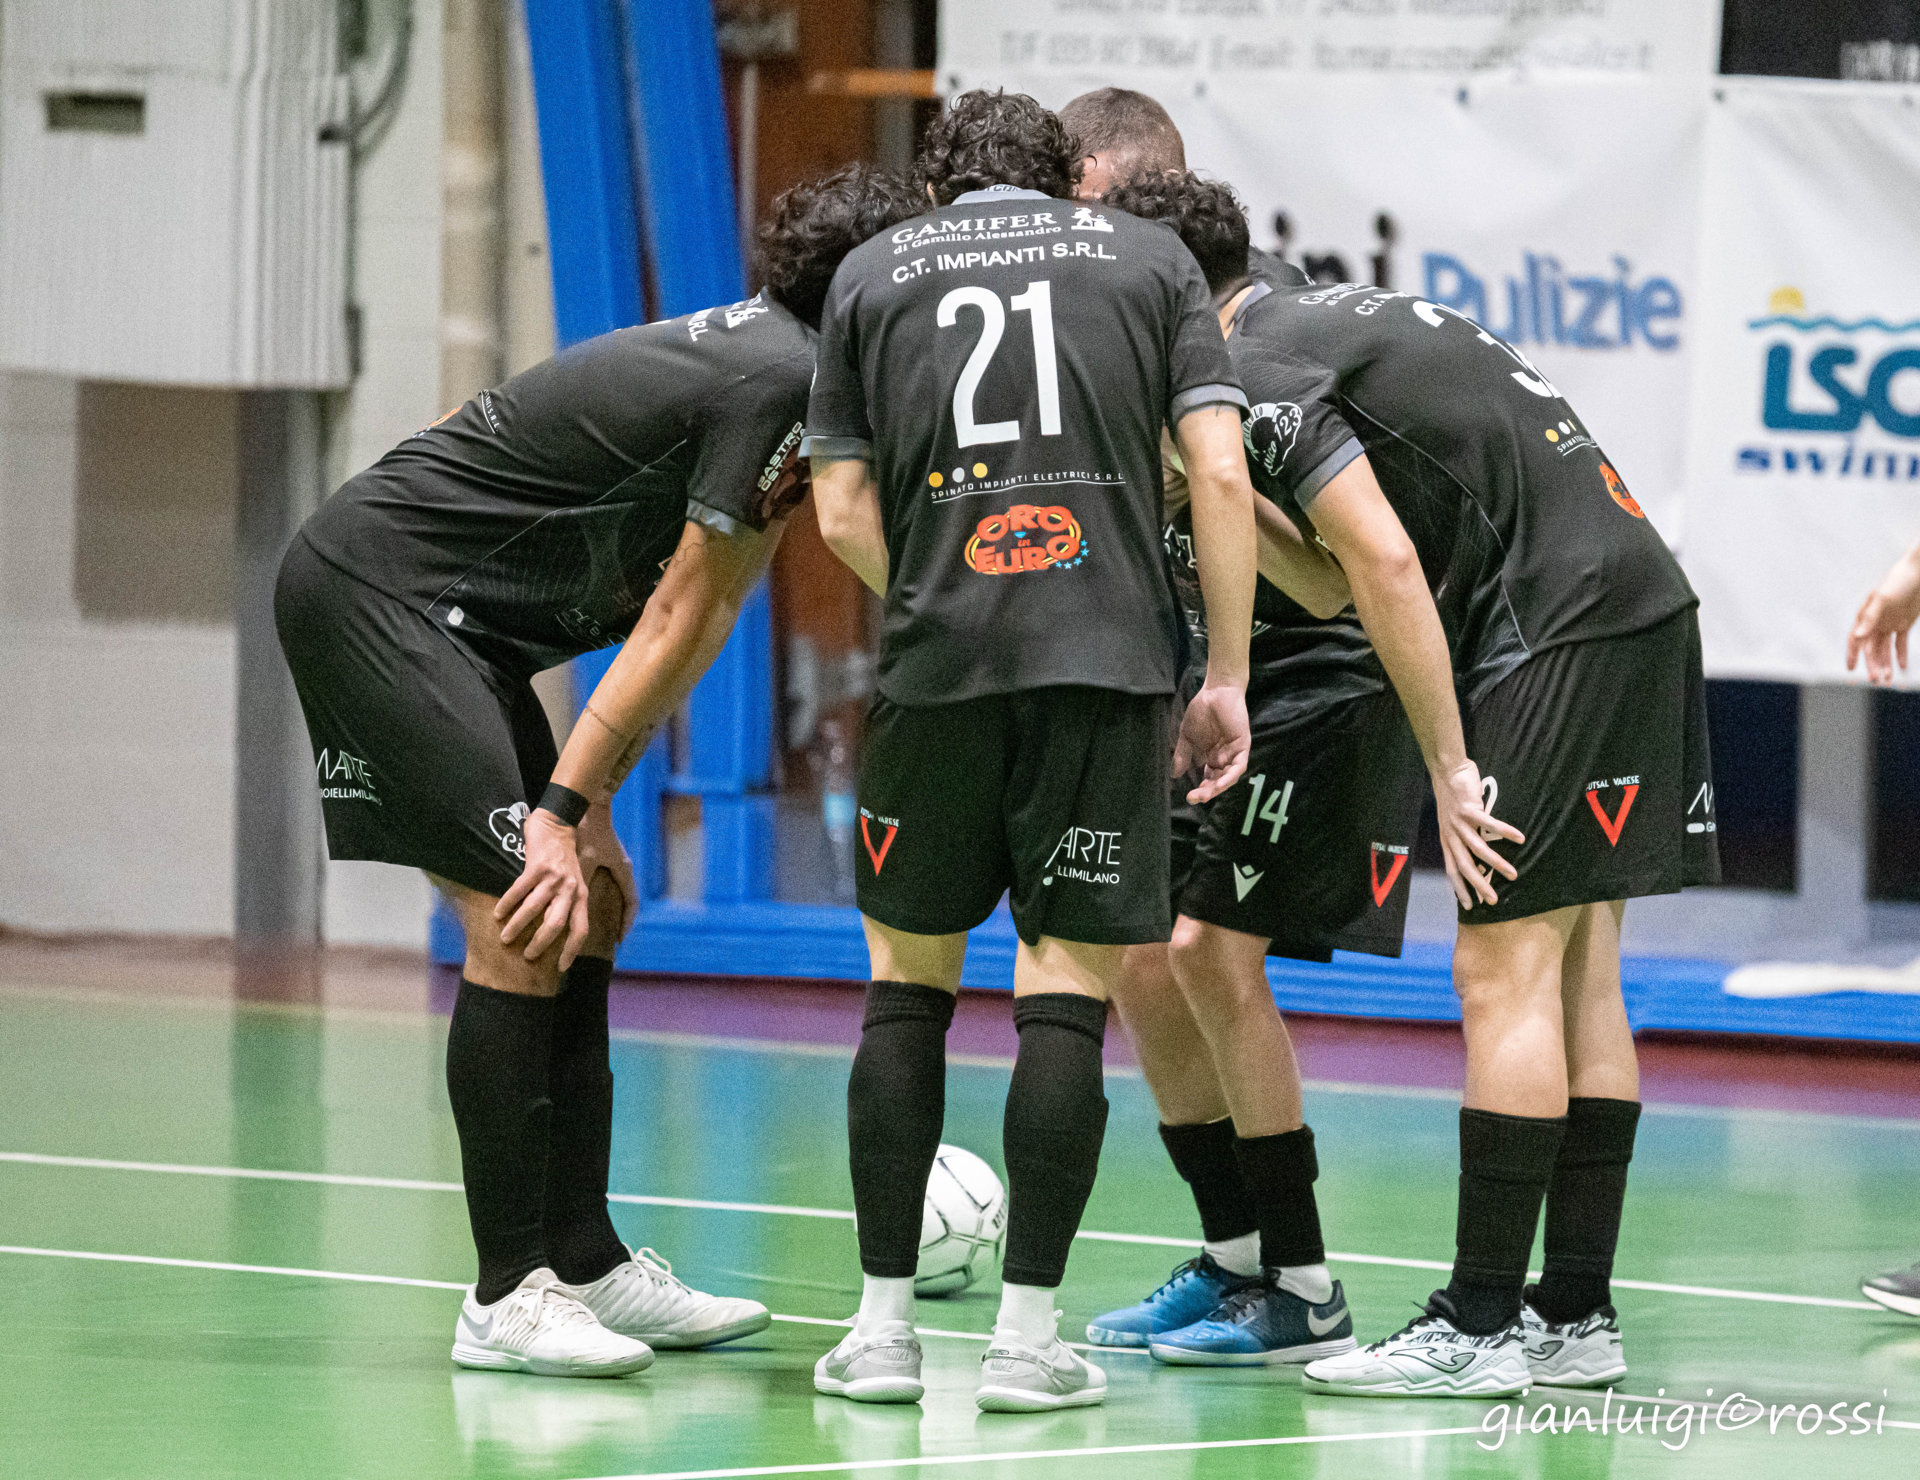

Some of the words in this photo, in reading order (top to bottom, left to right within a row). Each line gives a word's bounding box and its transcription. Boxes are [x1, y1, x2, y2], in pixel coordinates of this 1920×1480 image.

[891, 212, 1057, 244] GAMIFER
[974, 226, 1062, 240] Alessandro
[892, 258, 931, 284] C.T.
[937, 246, 1045, 271] IMPIANTI
[1052, 241, 1117, 260] S.R.L.
[936, 280, 1062, 449] 21
[931, 483, 975, 499] SPINATO
[979, 475, 1028, 489] IMPIANTI
[1033, 471, 1091, 481] ELETTRICI
[976, 504, 1073, 542] ORO
[974, 535, 1080, 574] EURO
[1612, 775, 1640, 786] VARESE
[1240, 773, 1295, 844] 14
[1055, 865, 1120, 884] LLIMILANO
